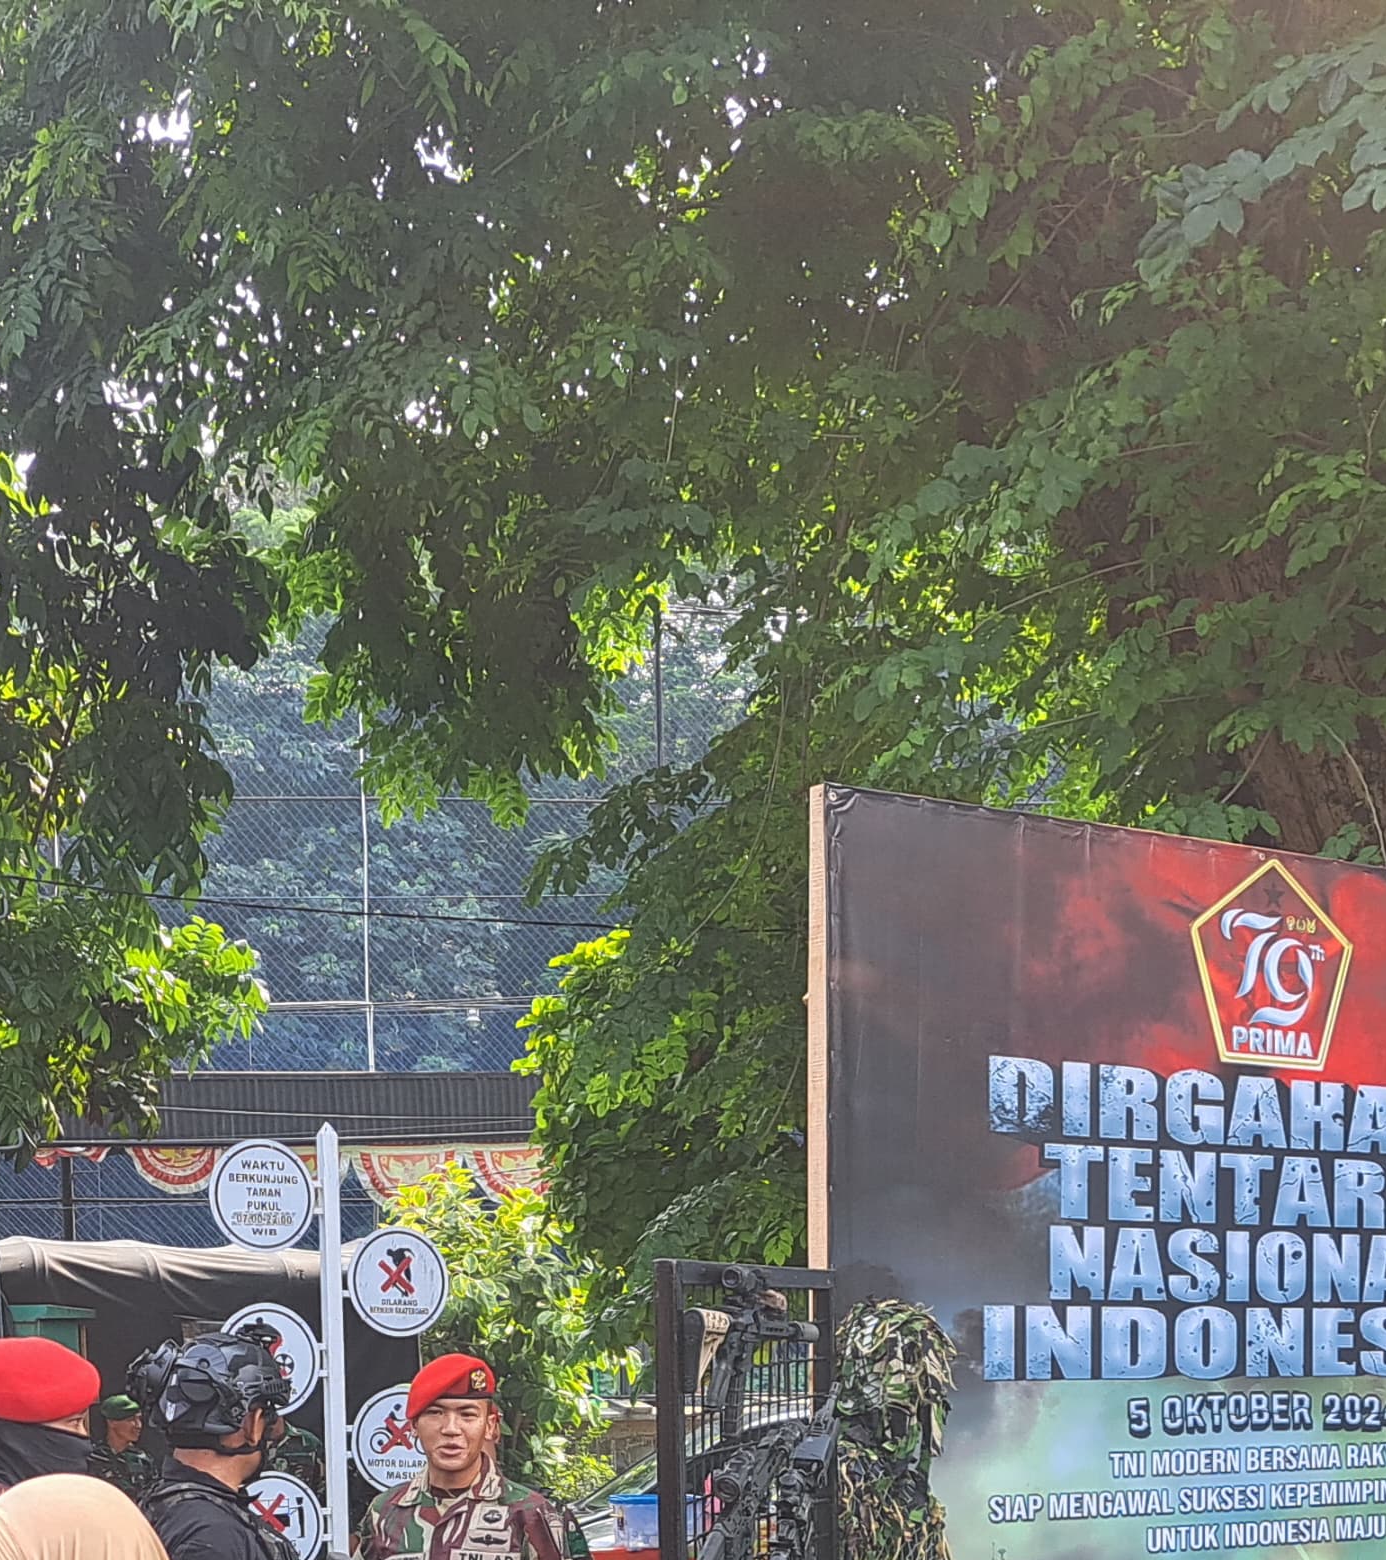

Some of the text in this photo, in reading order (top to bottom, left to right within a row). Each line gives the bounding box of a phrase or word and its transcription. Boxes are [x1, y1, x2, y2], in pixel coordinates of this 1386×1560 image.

[1232, 1025, 1314, 1058] PRIMA
[241, 1159, 285, 1171] WAKTU
[228, 1173, 299, 1184] BERKUNJUNG
[246, 1187, 282, 1197] TAMAN
[247, 1201, 282, 1211] PUKUL
[252, 1228, 278, 1236] WIB
[1128, 1397, 1152, 1437] 5
[1163, 1392, 1312, 1436] OKTOBER
[368, 1459, 428, 1468] MOTOR DILARA
[1109, 1452, 1146, 1477] TNI
[1151, 1449, 1240, 1476] MODERN
[1246, 1444, 1341, 1472] BERSAMA
[386, 1471, 417, 1480] MASU
[989, 1494, 1043, 1523] SIAP
[1048, 1490, 1173, 1519] MENGAWAL
[1179, 1485, 1264, 1513] SUKSESI
[1146, 1515, 1386, 1553] UNTUK INDONESIA MAJU
